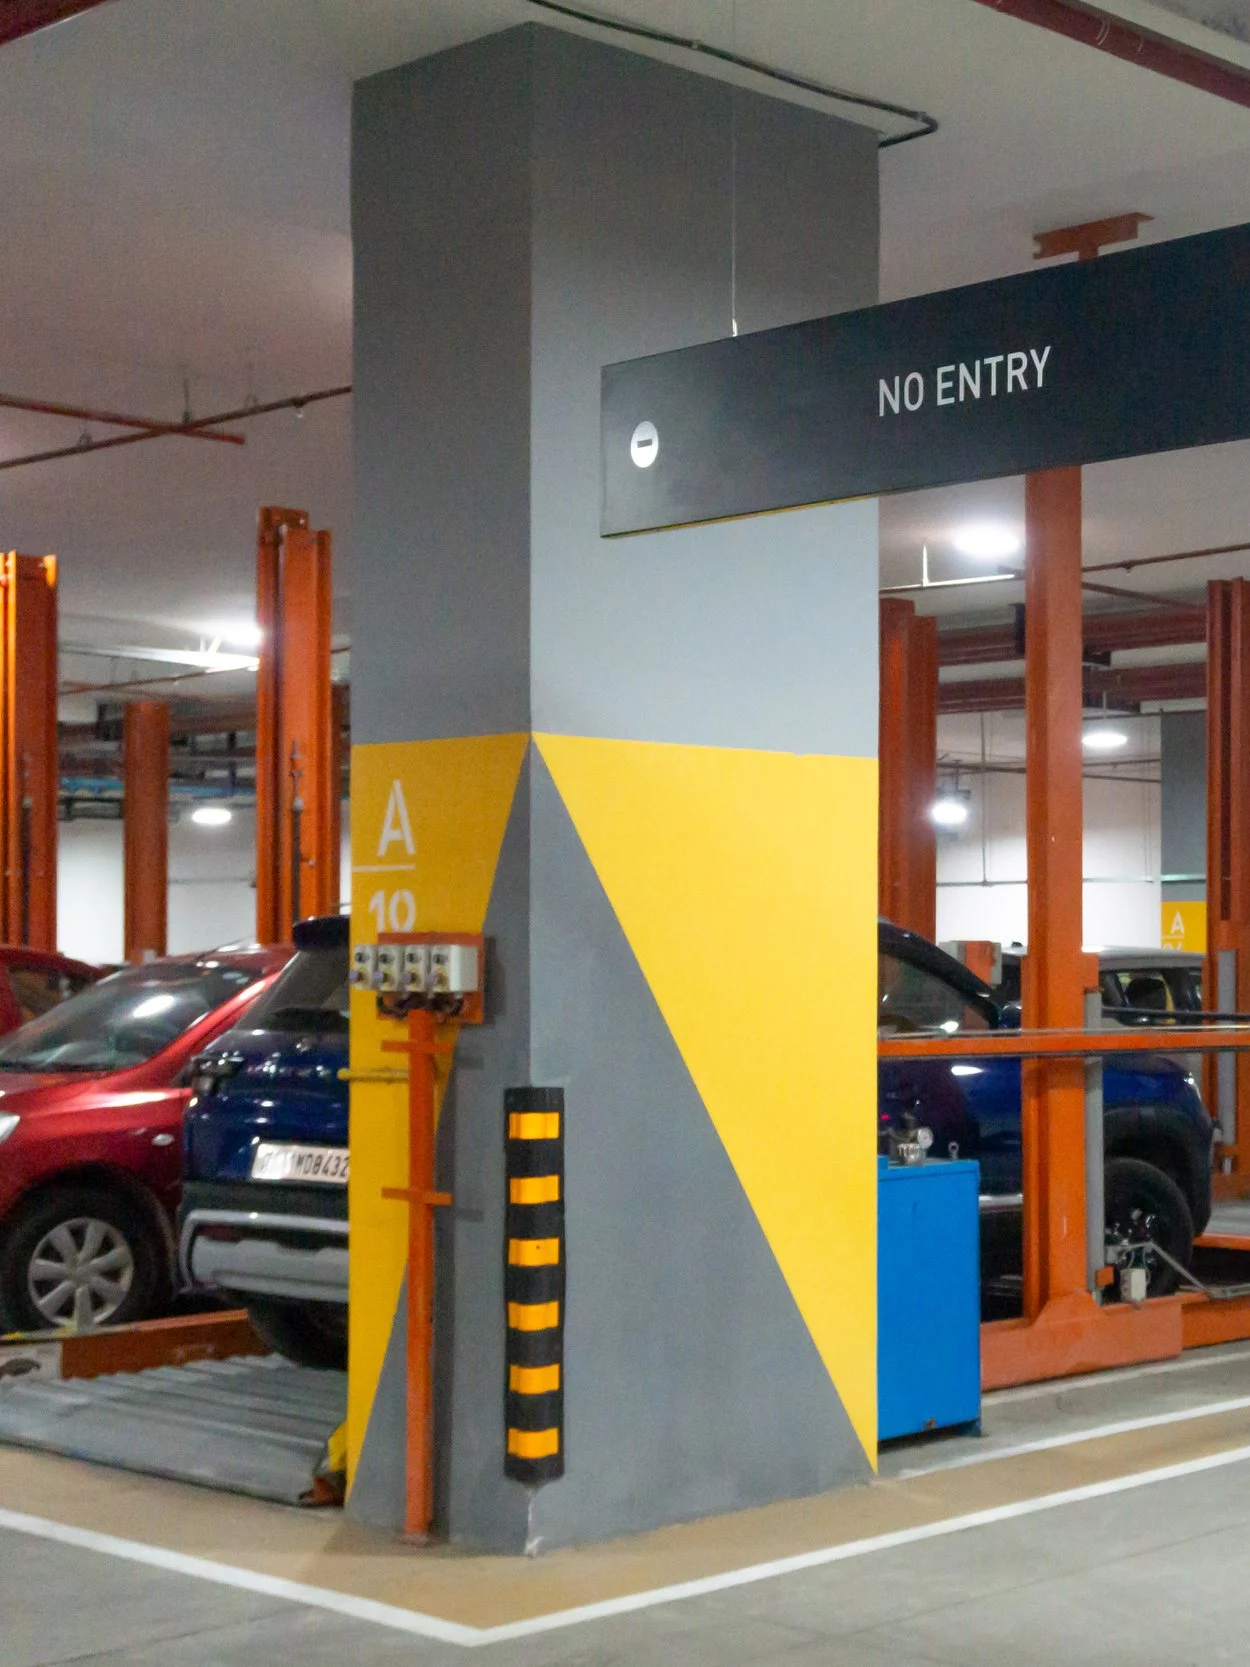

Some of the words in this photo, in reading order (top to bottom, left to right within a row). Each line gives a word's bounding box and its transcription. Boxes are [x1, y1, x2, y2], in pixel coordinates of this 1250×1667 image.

[878, 371, 924, 417] NO
[936, 345, 1051, 406] ENTRY
[377, 778, 416, 857] A
[369, 887, 416, 934] 10
